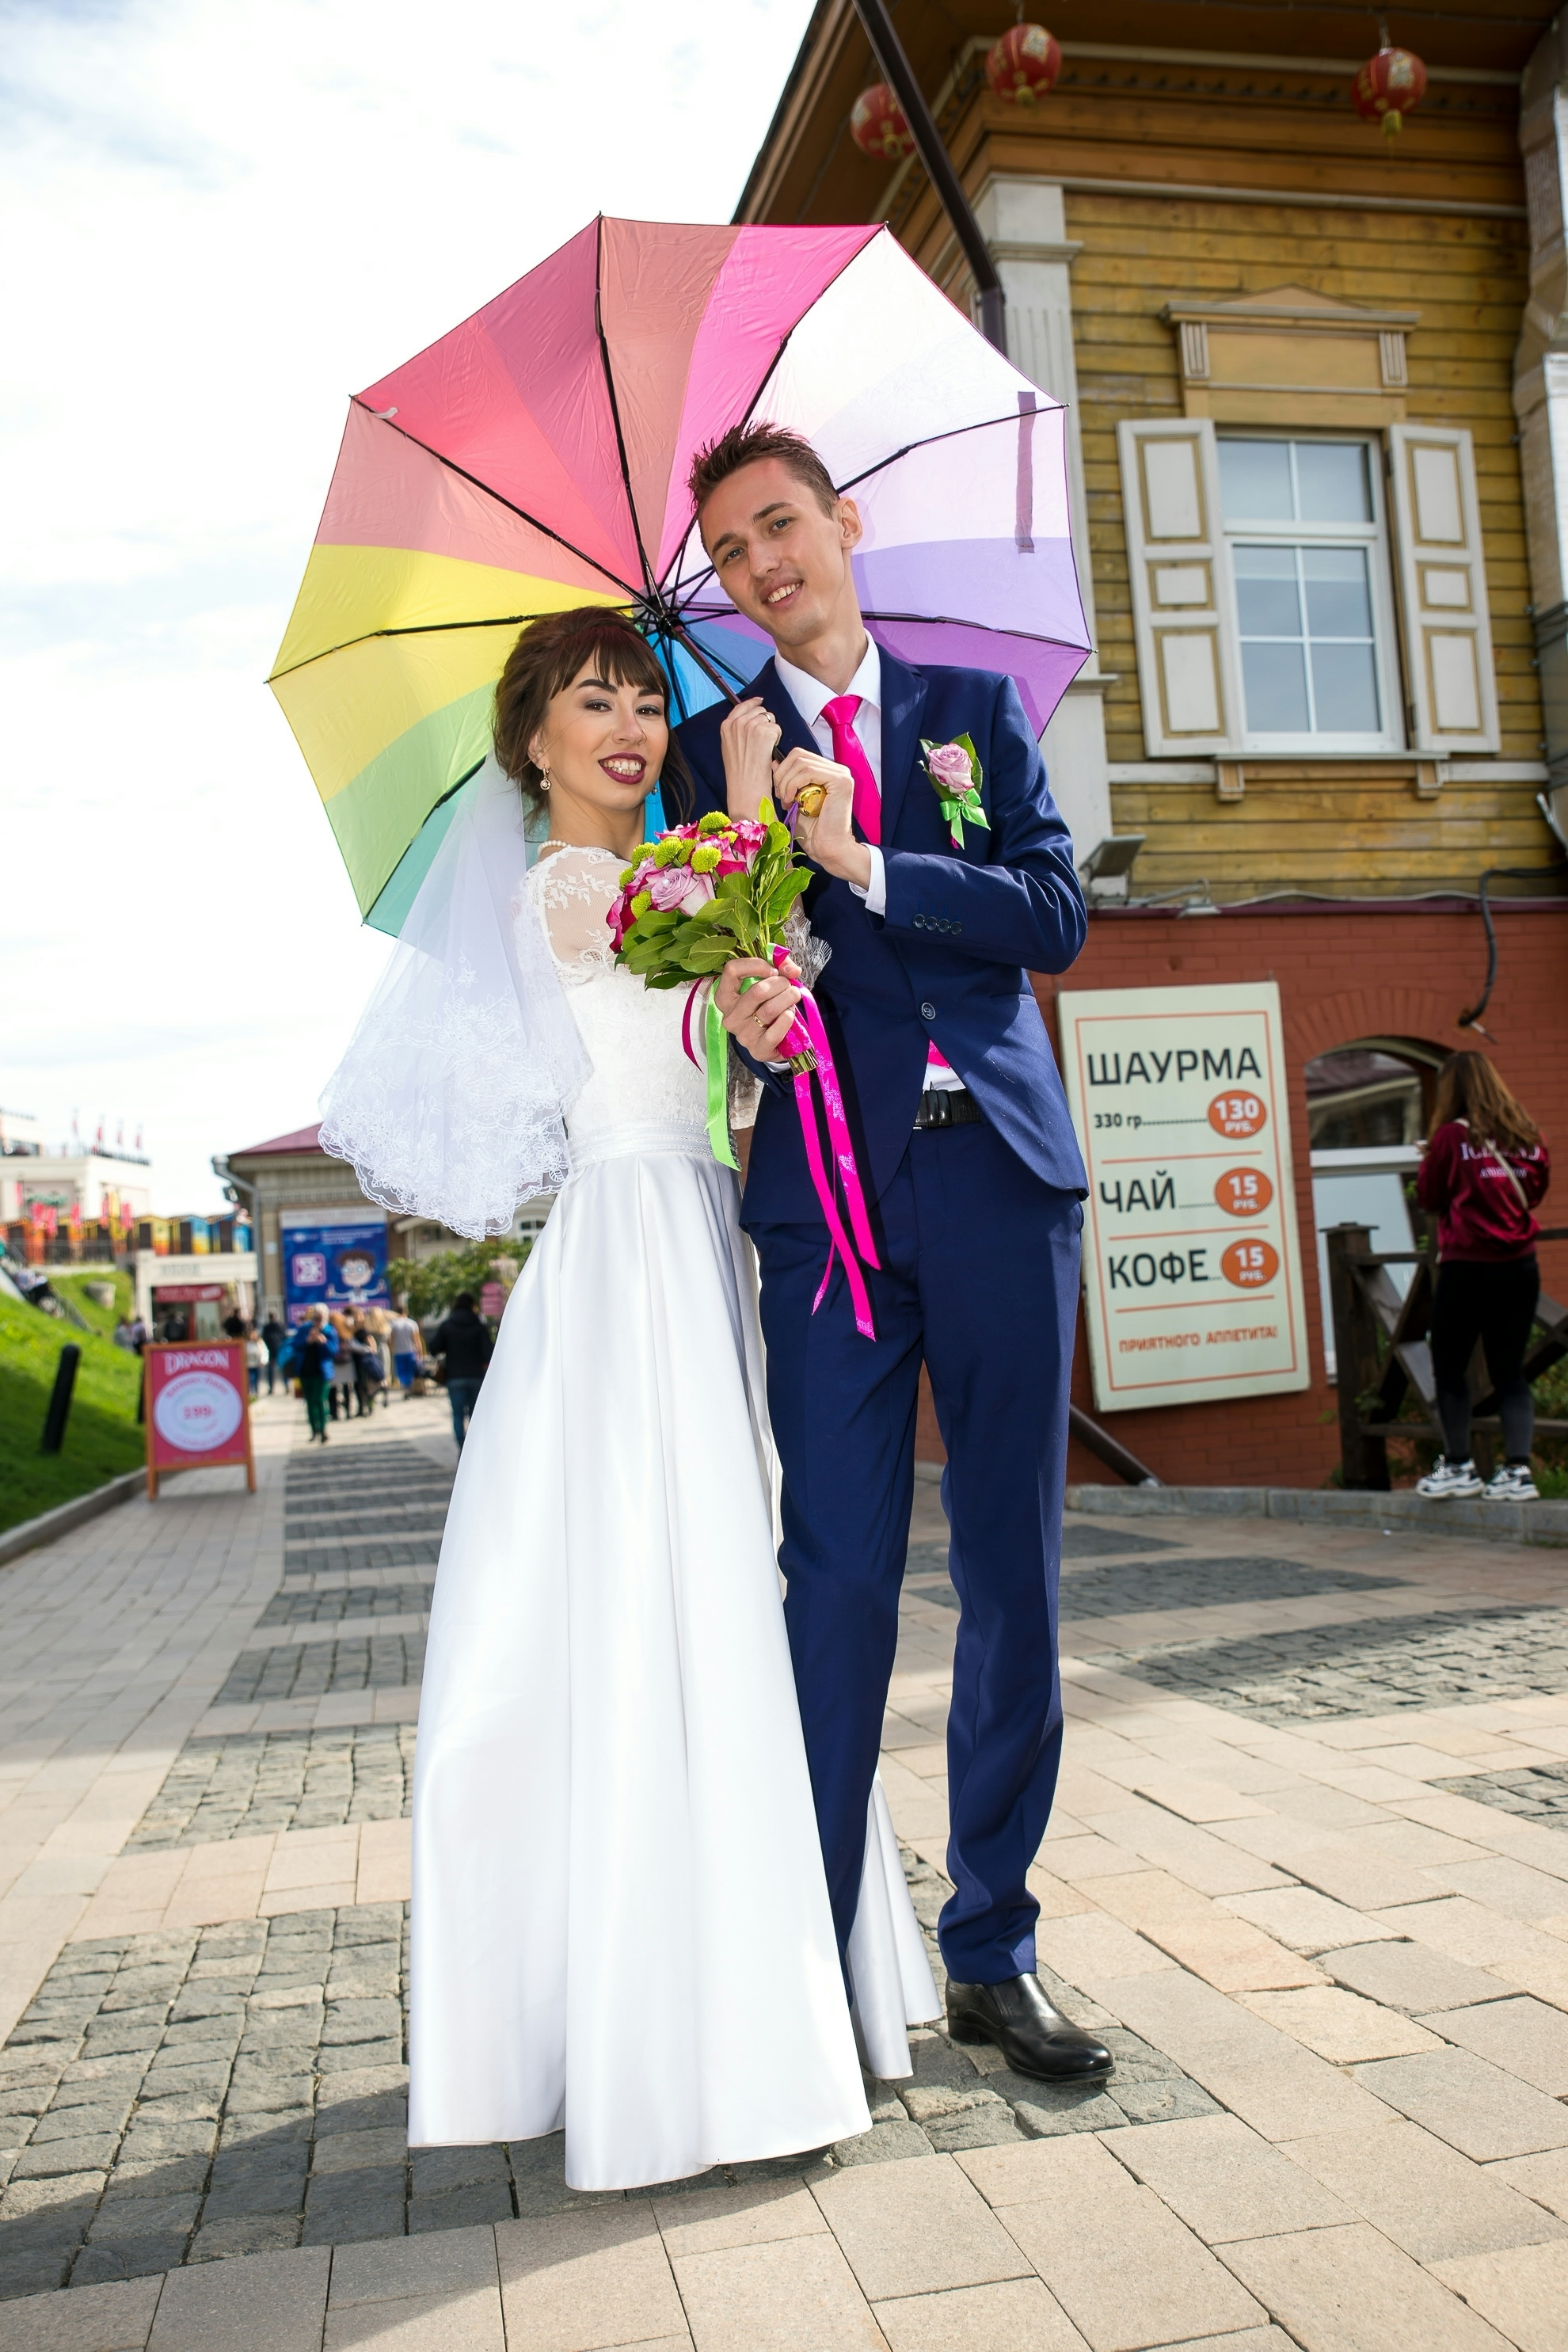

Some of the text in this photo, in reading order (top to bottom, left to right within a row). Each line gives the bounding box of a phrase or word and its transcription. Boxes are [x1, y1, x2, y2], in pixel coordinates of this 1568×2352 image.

[1087, 1047, 1262, 1086] ШАУРМА
[1094, 1113, 1122, 1128] 330
[1215, 1098, 1259, 1120] 130
[1224, 1121, 1256, 1133] РУБ.
[1100, 1170, 1176, 1212] ЧАЙ
[1229, 1174, 1258, 1197] 15
[1109, 1249, 1209, 1289] КОФЕ
[1235, 1246, 1265, 1268] 15
[1119, 1325, 1278, 1353] ПРИЯТНОГО АППЕТИТА!
[164, 1349, 230, 1376] DRAGON
